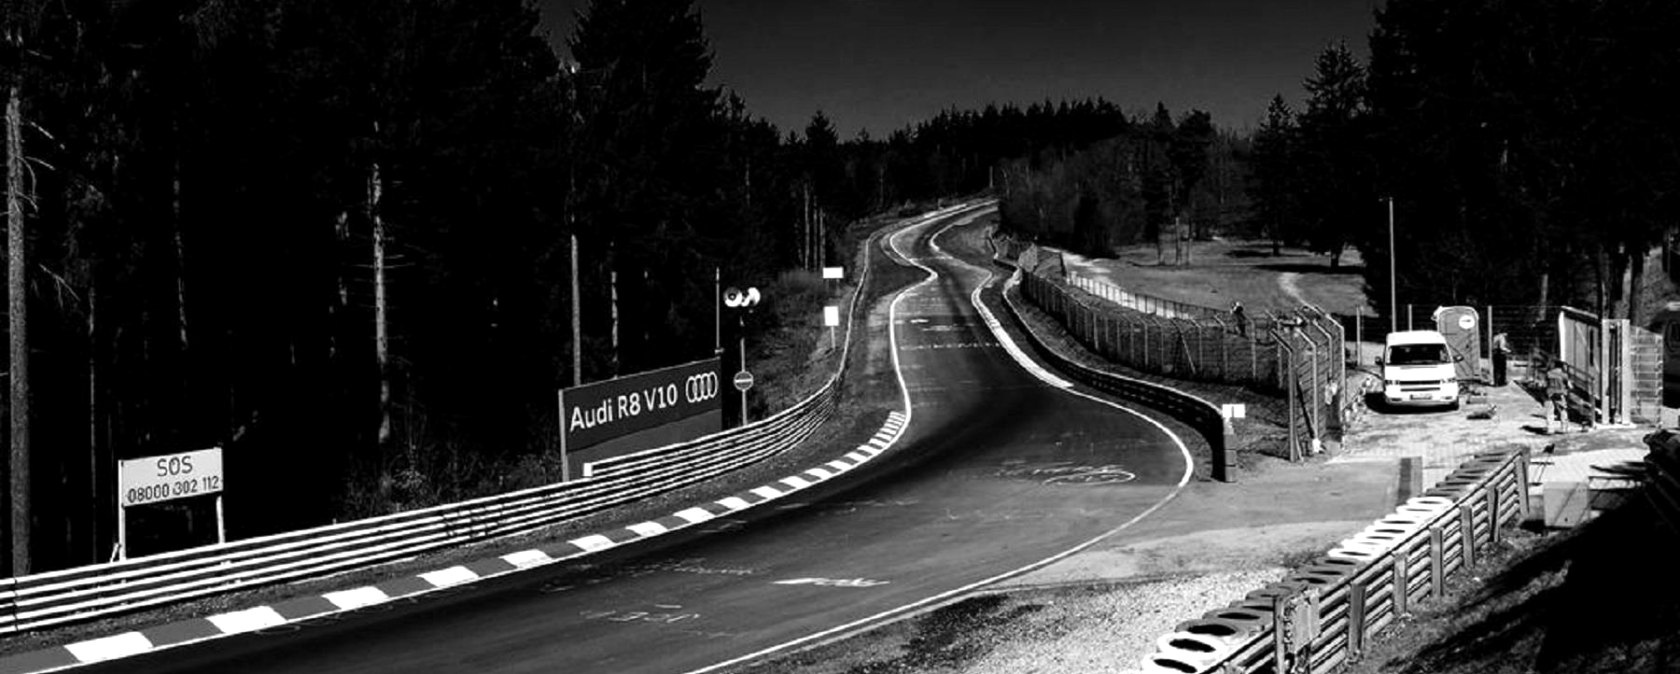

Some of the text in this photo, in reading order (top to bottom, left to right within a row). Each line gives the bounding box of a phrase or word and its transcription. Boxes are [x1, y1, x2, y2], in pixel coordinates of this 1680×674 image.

[570, 383, 678, 432] Audi R8 V10
[157, 455, 193, 477] SOS
[127, 475, 219, 503] 08000 302 112
